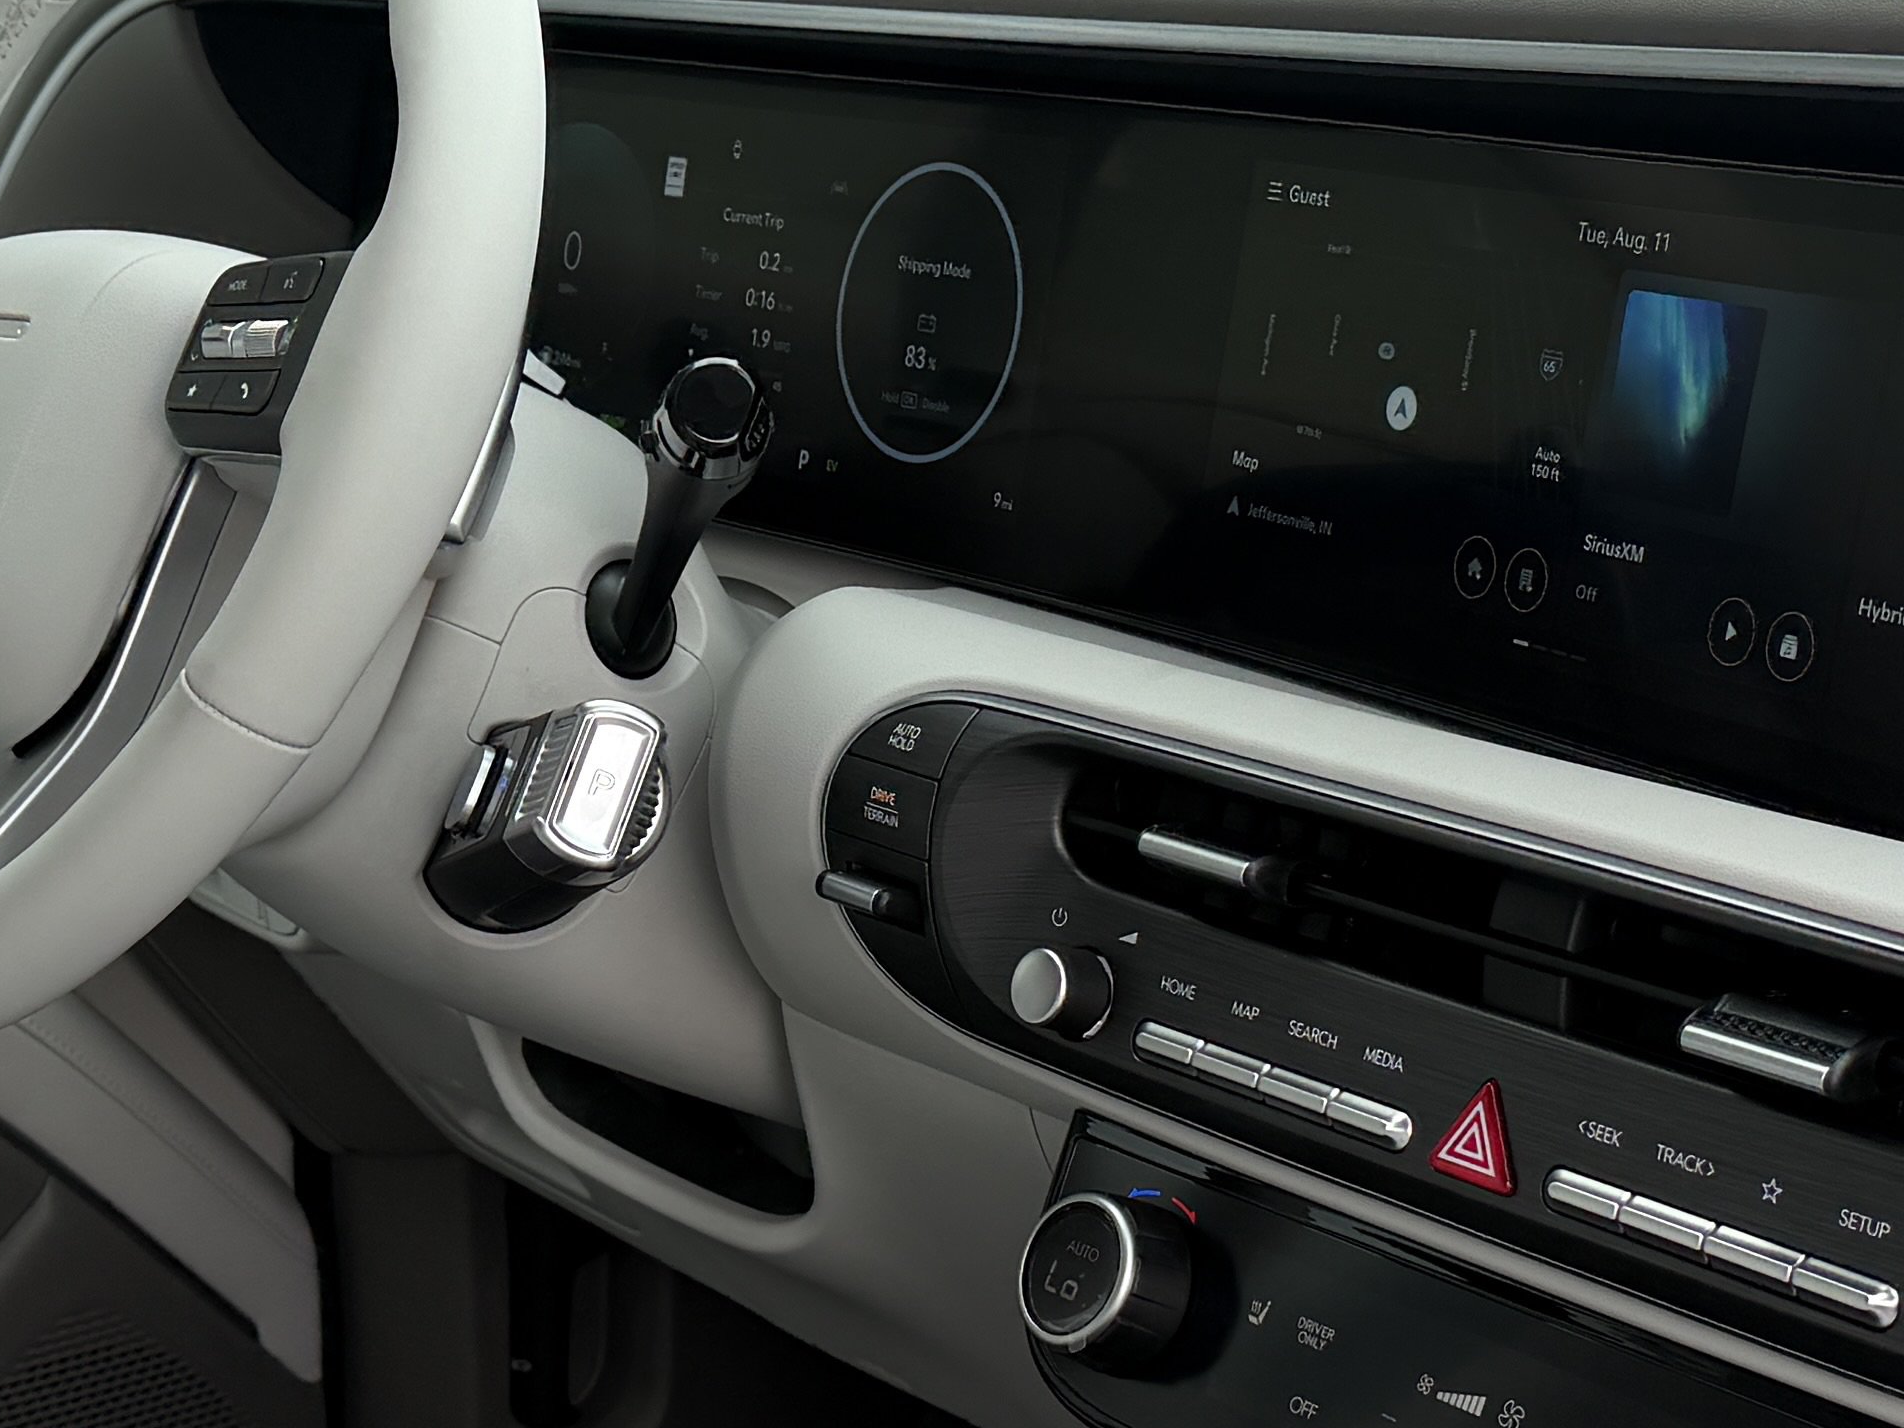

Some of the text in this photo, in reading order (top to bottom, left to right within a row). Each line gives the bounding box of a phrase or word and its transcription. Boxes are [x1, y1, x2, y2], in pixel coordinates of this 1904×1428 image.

[1289, 183, 1331, 209] Guest
[723, 207, 784, 231] Current Trip
[1577, 221, 1671, 256] Tue, Aug. 11
[759, 250, 782, 272] 0.2
[898, 254, 972, 280] Shipping Mode
[745, 288, 776, 311] 0:16
[751, 328, 772, 348] 1.9
[798, 448, 810, 470] P
[1232, 451, 1260, 473] Map
[1535, 445, 1562, 464] Auto
[1530, 464, 1551, 483] 150
[1582, 533, 1647, 564] SiriusXM
[1575, 582, 1599, 603] Off
[887, 734, 916, 752] HOLD
[892, 723, 922, 740] AUTO
[870, 786, 897, 806] DRIVE
[863, 806, 899, 829] TERRAIN
[1160, 975, 1196, 1001] HOME
[1230, 1000, 1261, 1022] MAP
[1287, 1018, 1339, 1051] SEARCH
[1362, 1045, 1404, 1074] MEDIA
[1839, 1207, 1892, 1240] SETUP
[1066, 1237, 1101, 1264] AUTO
[1297, 1314, 1336, 1342] DRIVER
[1296, 1330, 1328, 1352] ONLY
[1288, 1396, 1320, 1421] OFF
